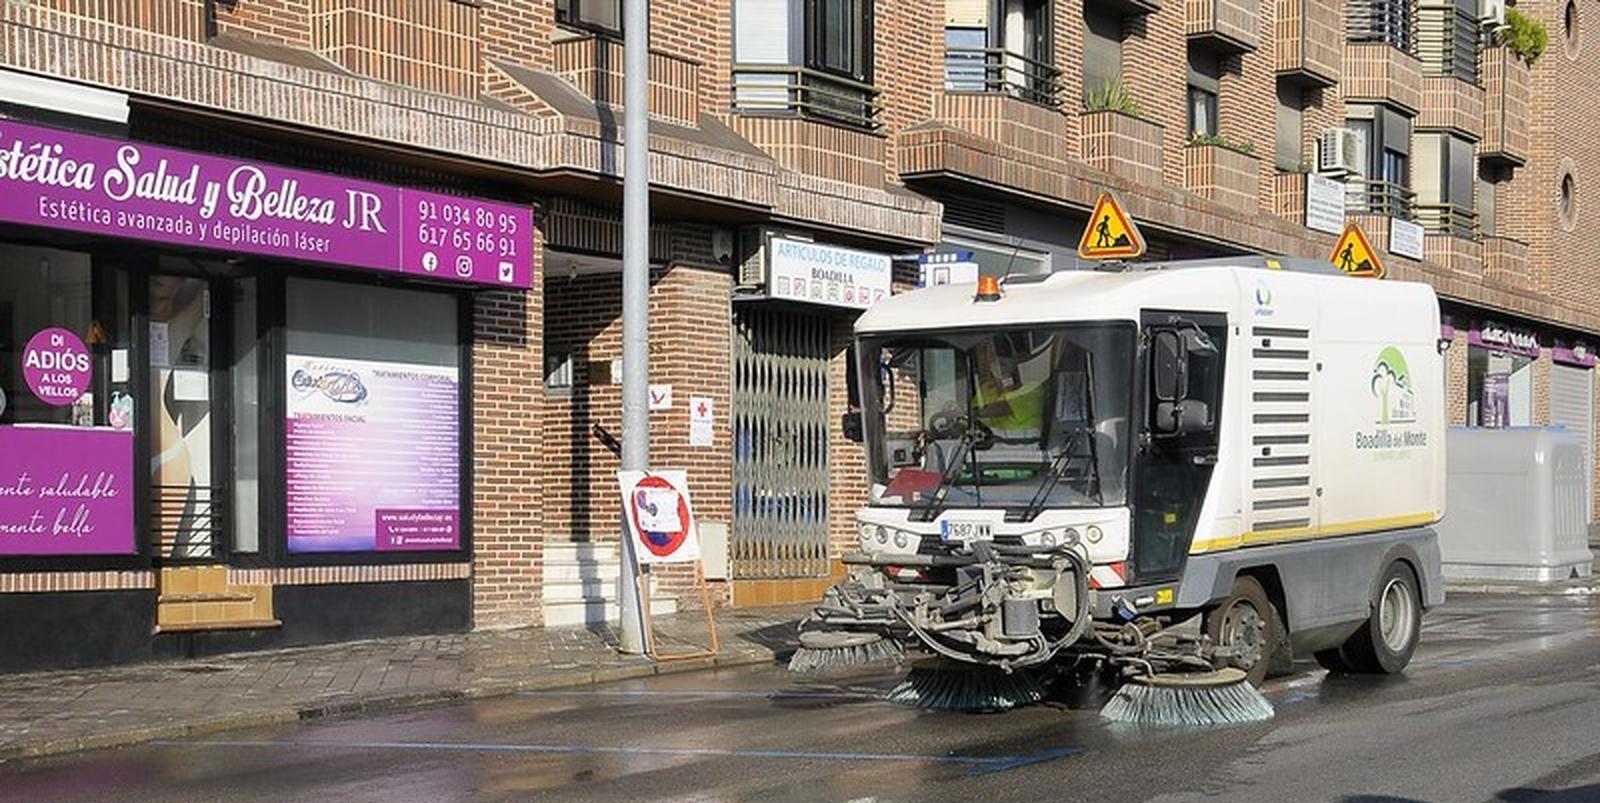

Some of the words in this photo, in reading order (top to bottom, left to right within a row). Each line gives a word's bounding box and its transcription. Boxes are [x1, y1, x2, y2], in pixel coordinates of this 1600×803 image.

[0, 139, 95, 191] stética
[104, 145, 199, 205] Salud
[200, 182, 220, 219] y
[227, 165, 336, 225] Belleza
[342, 189, 387, 234] JR
[39, 196, 111, 226] Estética
[117, 209, 193, 235] avanzada
[199, 222, 208, 240] y
[213, 221, 290, 249] depilación
[295, 232, 331, 254] láser
[419, 200, 438, 220] 91
[443, 204, 470, 225] 034
[475, 209, 496, 230] 80
[500, 214, 517, 234] 95
[419, 226, 447, 248] 617
[453, 231, 472, 251] 65
[476, 235, 496, 254] 66
[499, 238, 517, 257] 91
[835, 252, 847, 266] DE
[849, 254, 886, 272] REGALO
[811, 267, 854, 284] BOADILLA
[51, 335, 64, 346] DI
[25, 349, 90, 372] ADIÓS
[41, 375, 49, 384] A
[51, 374, 73, 385] LOS
[38, 385, 78, 398] VELLOS
[1355, 431, 1393, 449] Boadilla
[1404, 430, 1428, 446] Monte
[0, 473, 34, 498] ente
[40, 472, 118, 498] saludable
[53, 505, 95, 537] bella
[948, 523, 972, 536] 7687
